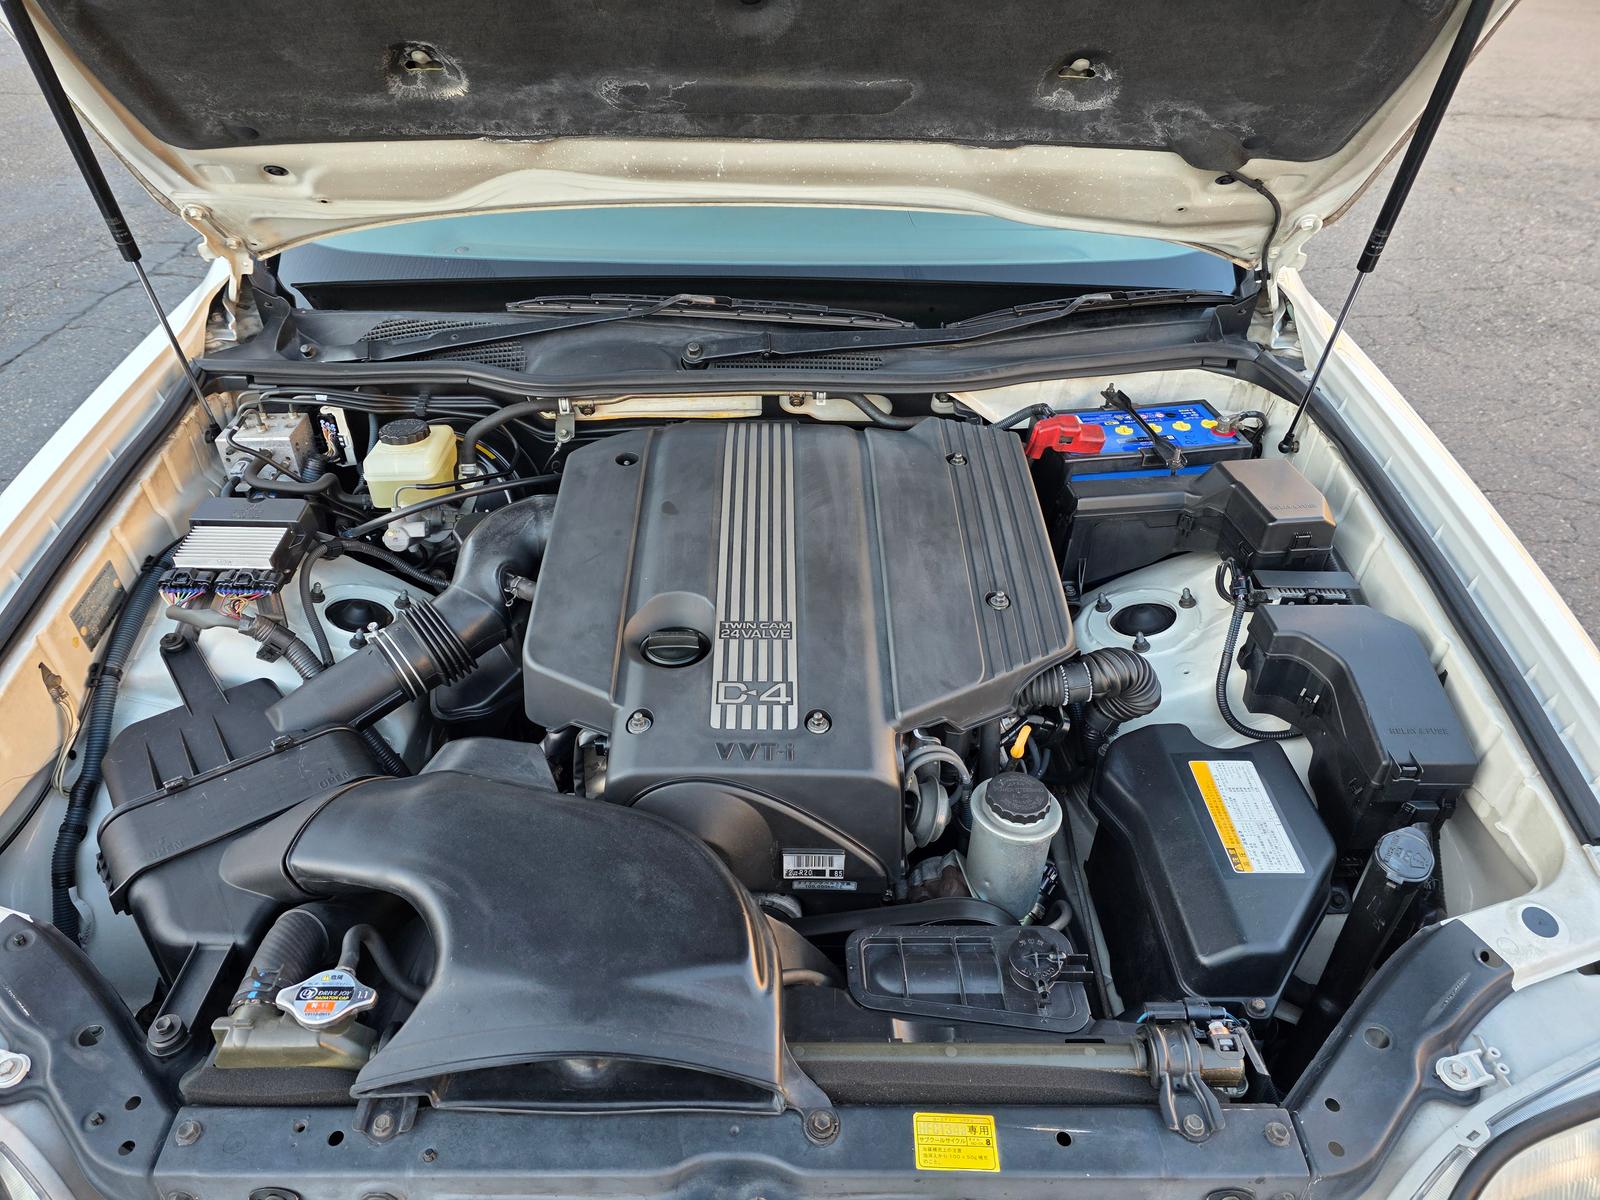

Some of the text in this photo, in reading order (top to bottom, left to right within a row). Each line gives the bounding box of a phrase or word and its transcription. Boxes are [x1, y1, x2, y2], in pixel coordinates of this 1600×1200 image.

[714, 742, 795, 761] VVT-i
[357, 990, 369, 999] 1.1
[985, 1138, 991, 1146] 8
